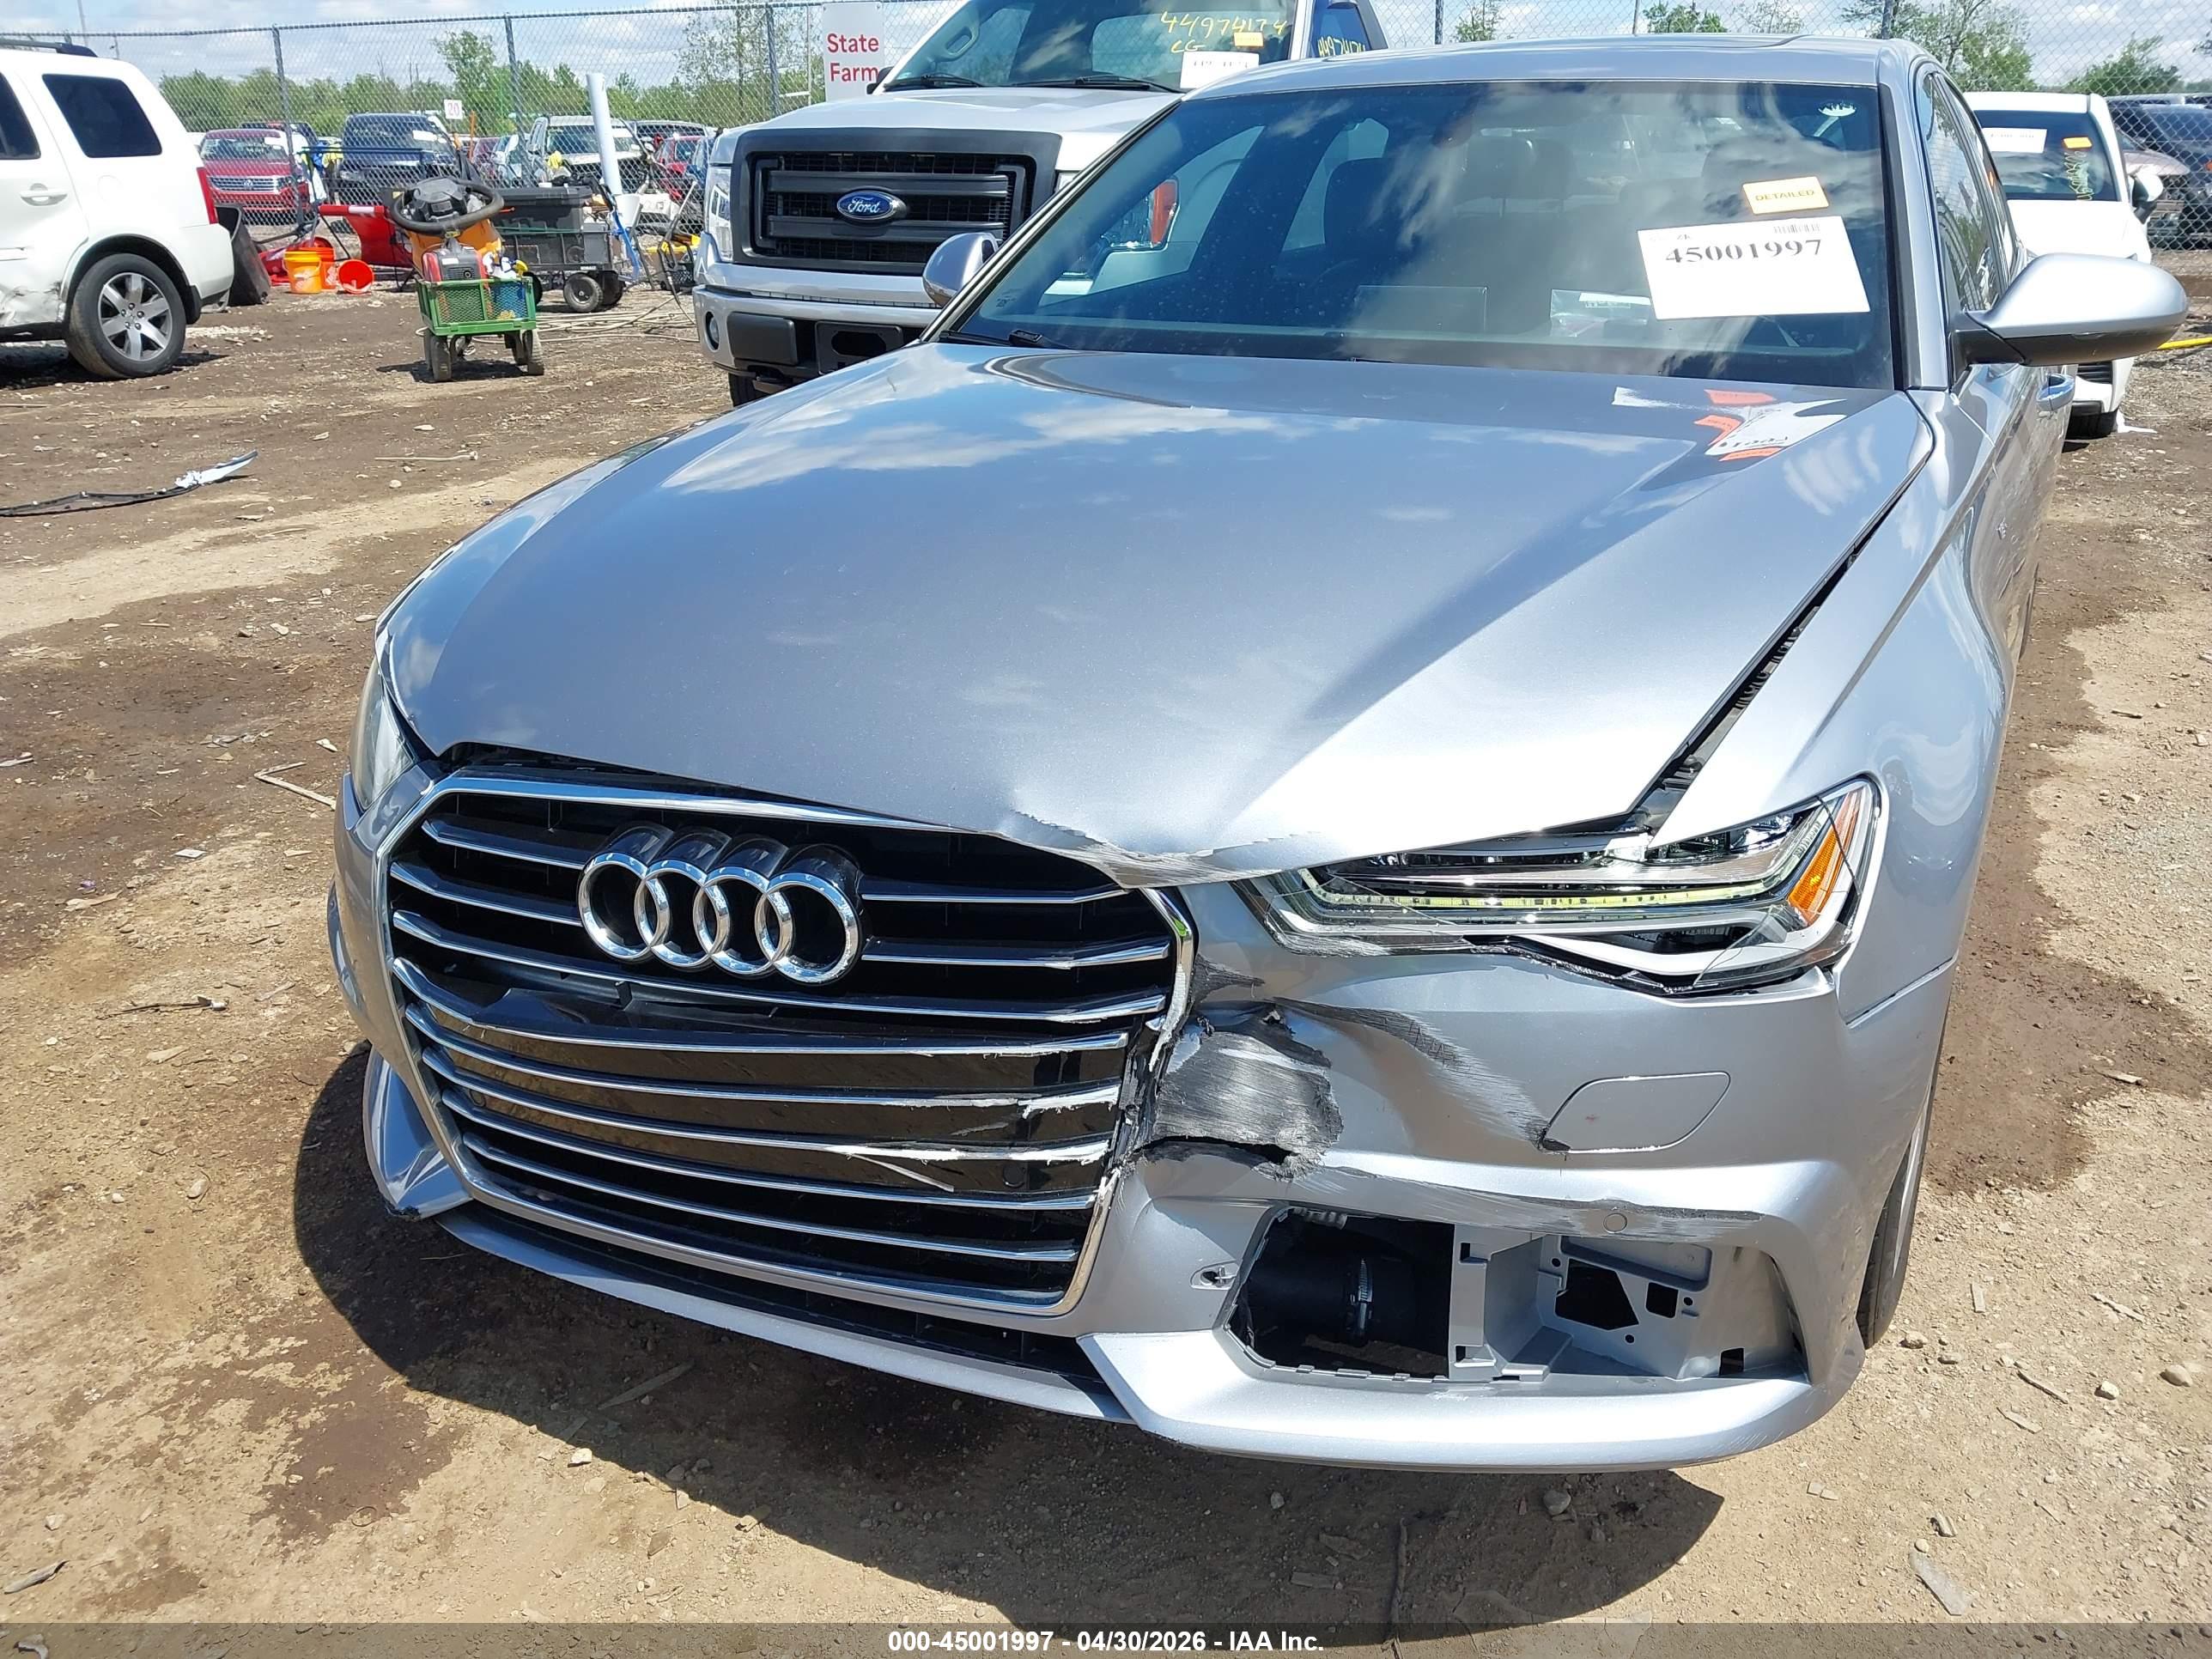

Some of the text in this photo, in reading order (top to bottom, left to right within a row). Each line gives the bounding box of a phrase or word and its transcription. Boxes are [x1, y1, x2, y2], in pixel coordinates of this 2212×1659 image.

[827, 33, 878, 52] State
[830, 62, 878, 82] Farm
[848, 196, 881, 214] Ford
[1755, 189, 1815, 202] DETAILED
[1666, 239, 1821, 263] 45001997
